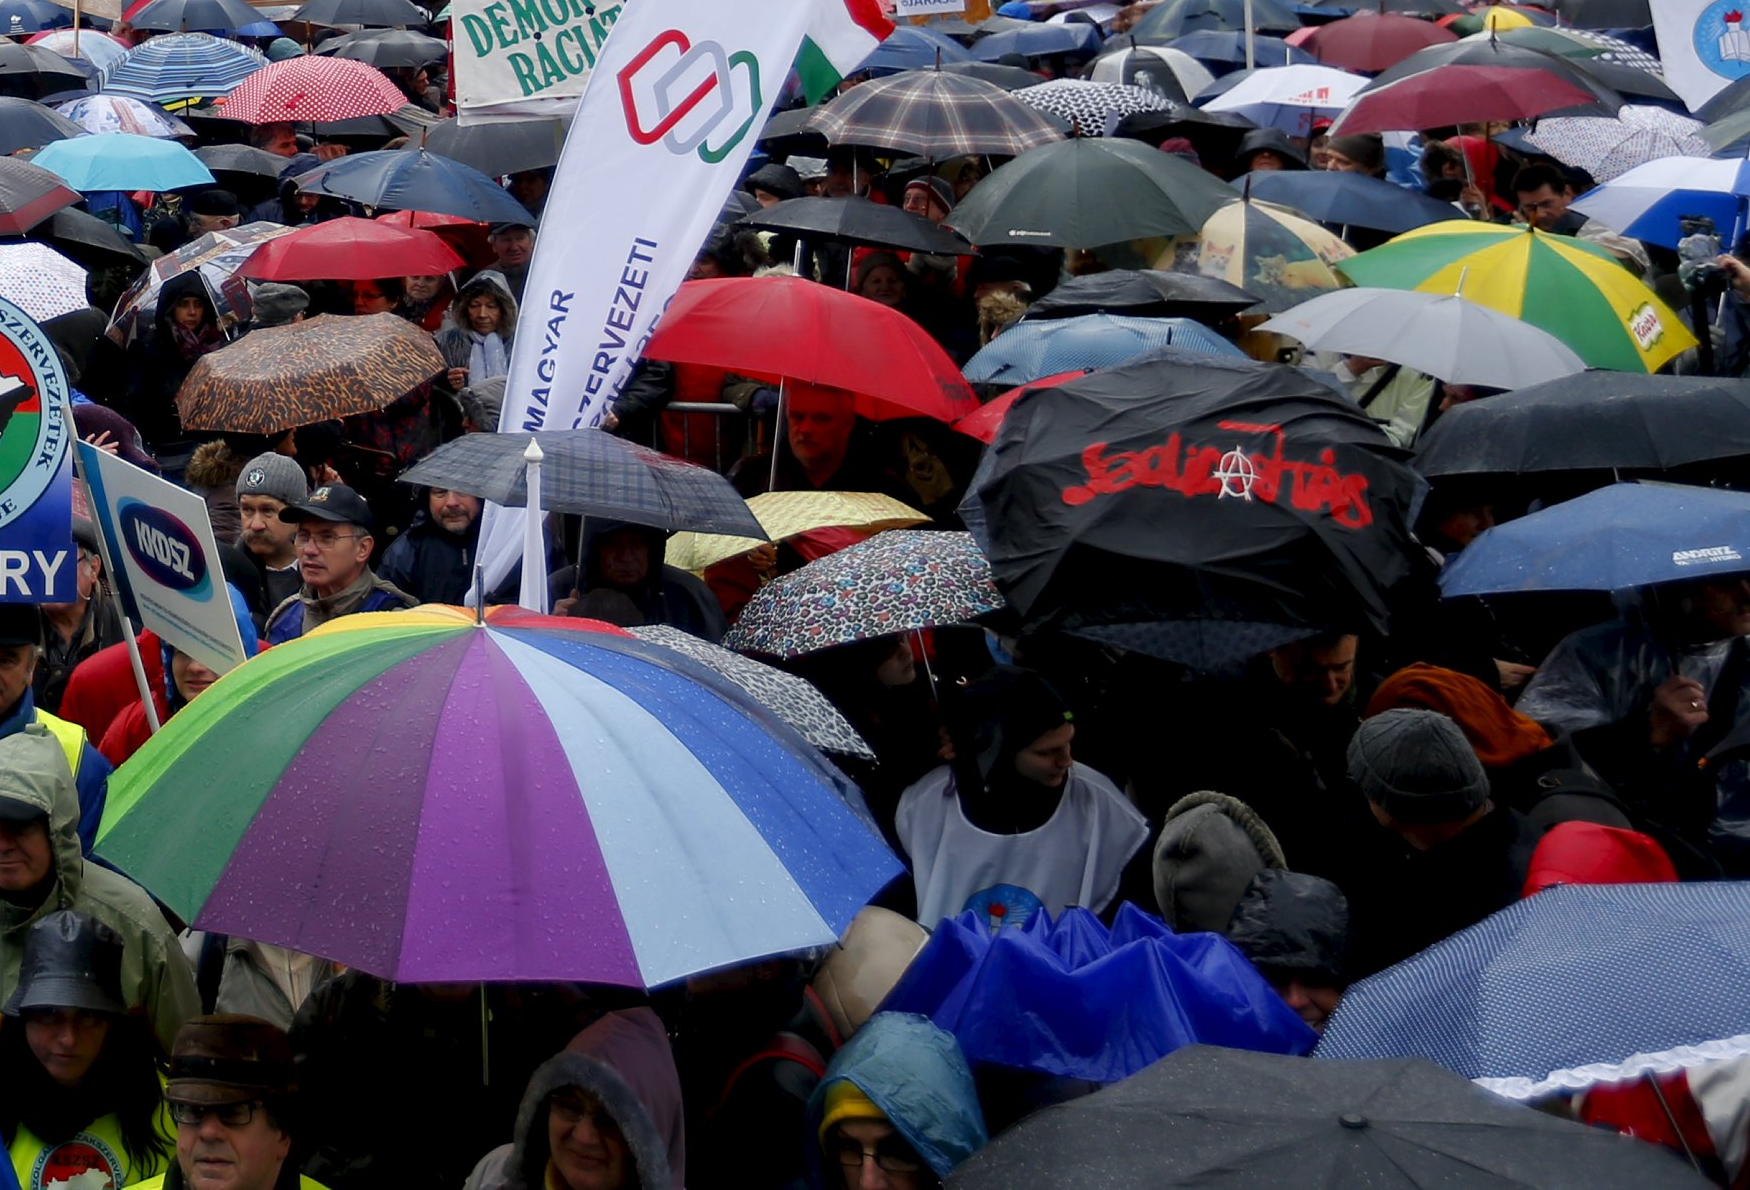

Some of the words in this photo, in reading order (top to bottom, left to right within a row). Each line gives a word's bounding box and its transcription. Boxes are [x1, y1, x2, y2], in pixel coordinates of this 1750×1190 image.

[521, 289, 575, 432] MAGYAR
[134, 517, 195, 581] KKDSZ
[1672, 545, 1739, 561] ANDRITZ
